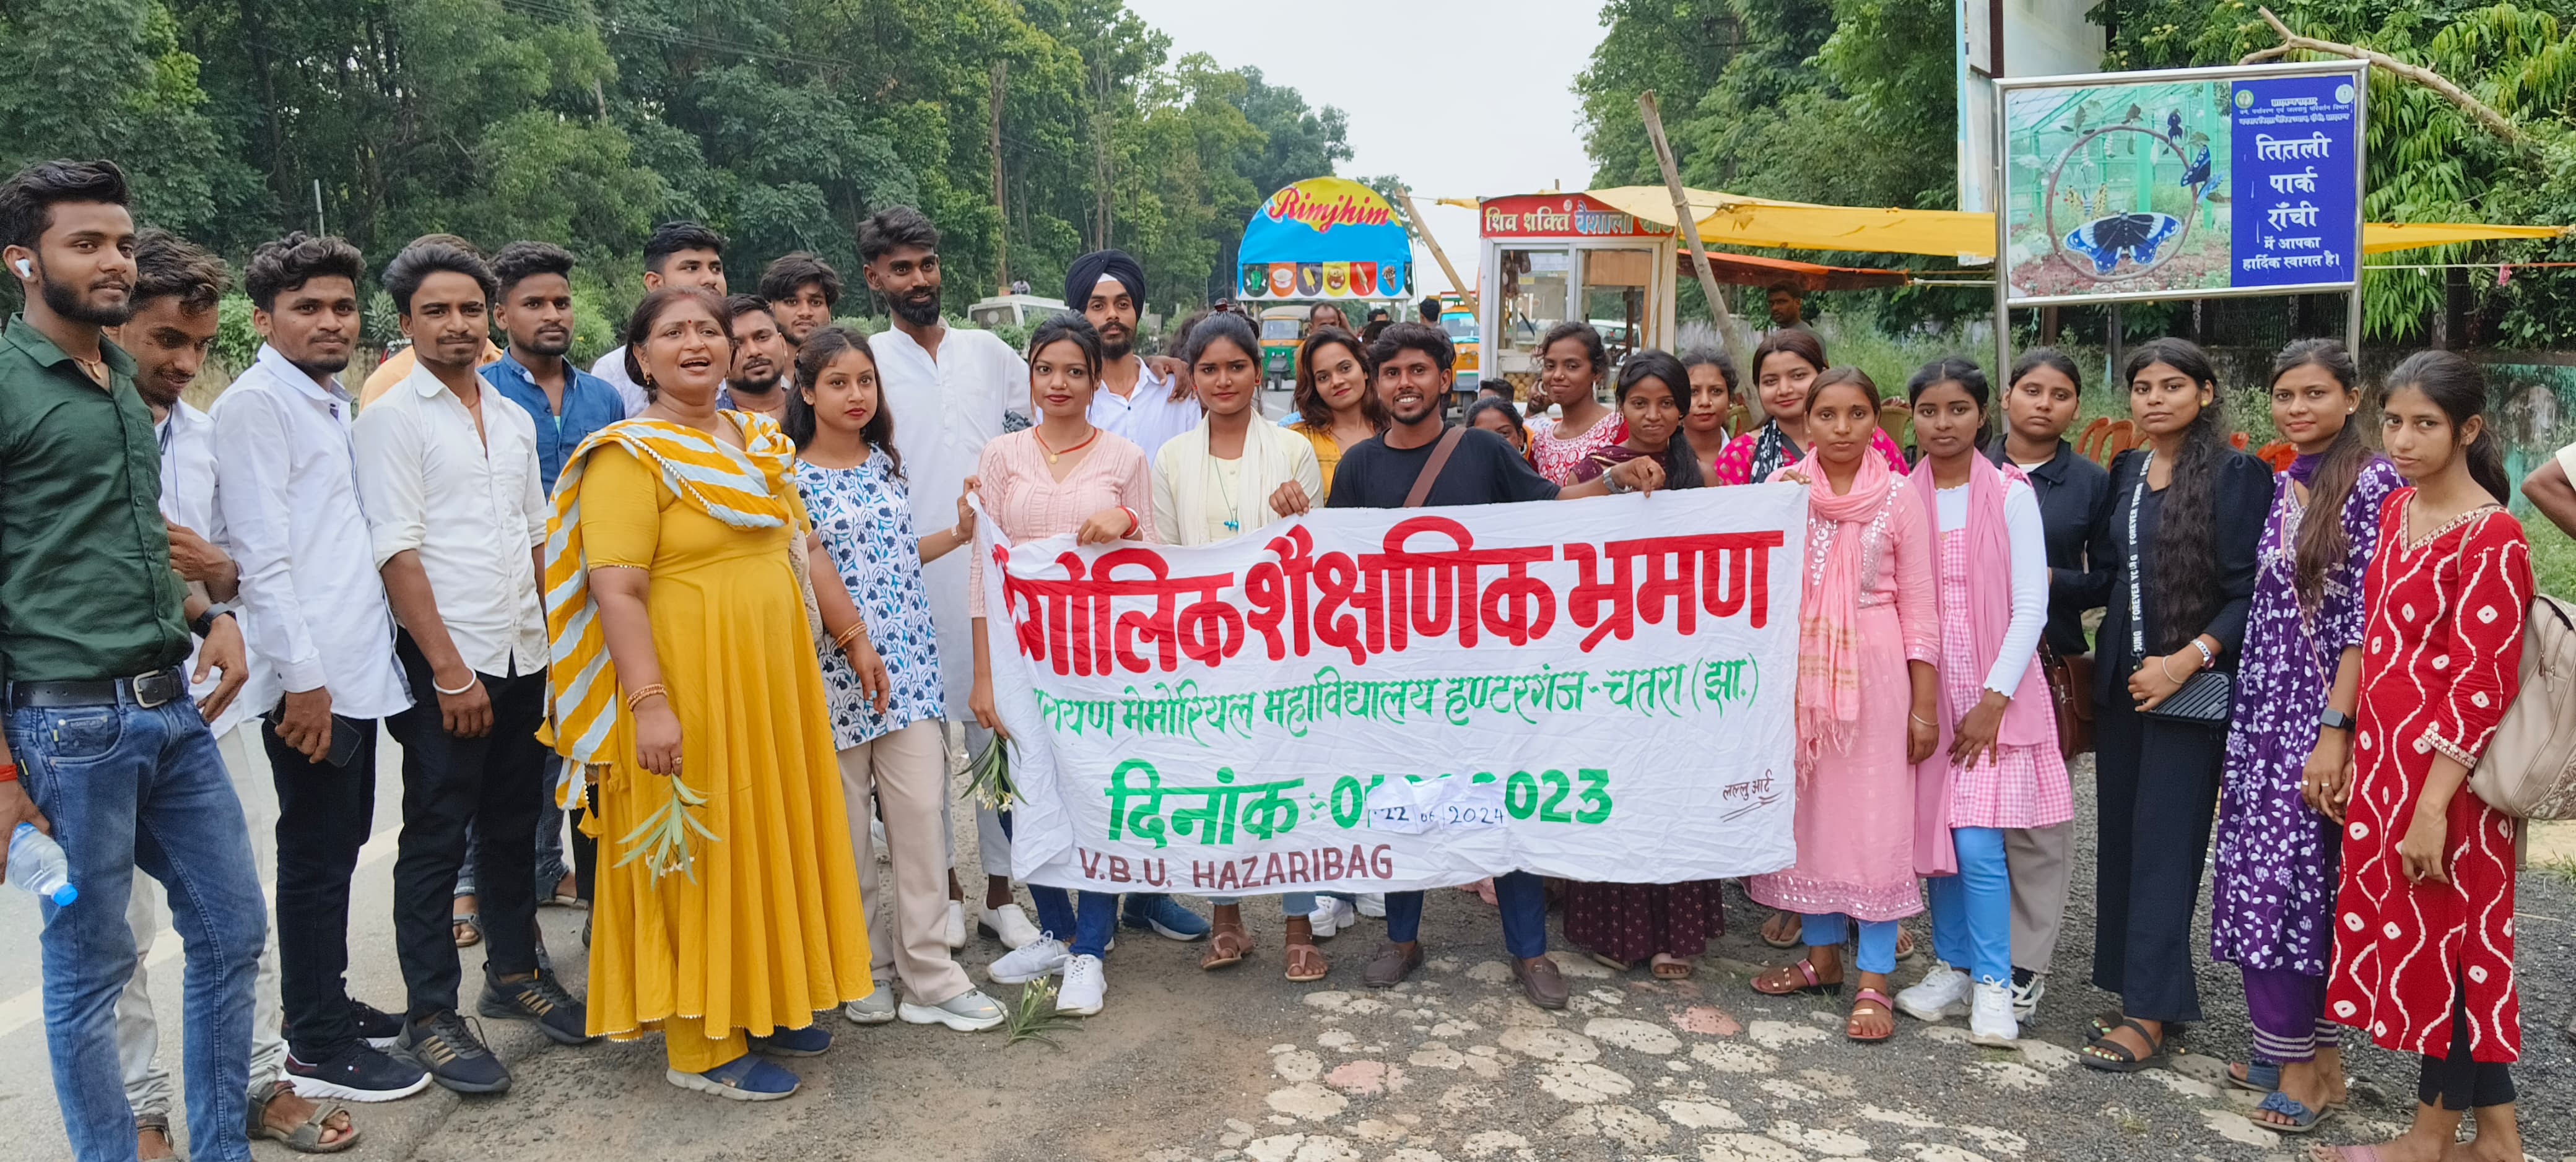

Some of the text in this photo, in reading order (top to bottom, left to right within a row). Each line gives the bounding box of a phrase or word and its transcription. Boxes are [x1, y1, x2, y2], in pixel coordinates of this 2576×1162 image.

[2256, 131, 2332, 161] तितली
[2269, 166, 2318, 194] पार्क
[1268, 187, 1390, 234] Rimjhim
[1485, 207, 1518, 233] शिव
[2268, 201, 2320, 232] राँची
[2264, 236, 2321, 250] में आपका
[2243, 254, 2281, 271] हार्दिक
[2284, 254, 2323, 269] स्वागत
[2129, 508, 2139, 545] FOREVER
[993, 516, 1784, 677] गोलिक शैक्षणिक भ्रमण
[2131, 583, 2141, 622] FOREVER
[1033, 687, 1116, 739] रायण
[1121, 679, 1258, 747] मेमोरियल
[1263, 666, 1442, 738] महाविद्यालय
[1751, 768, 1775, 794] आर्ट
[1448, 806, 1504, 825] 2024
[1193, 844, 1393, 890] HAZARIBAG
